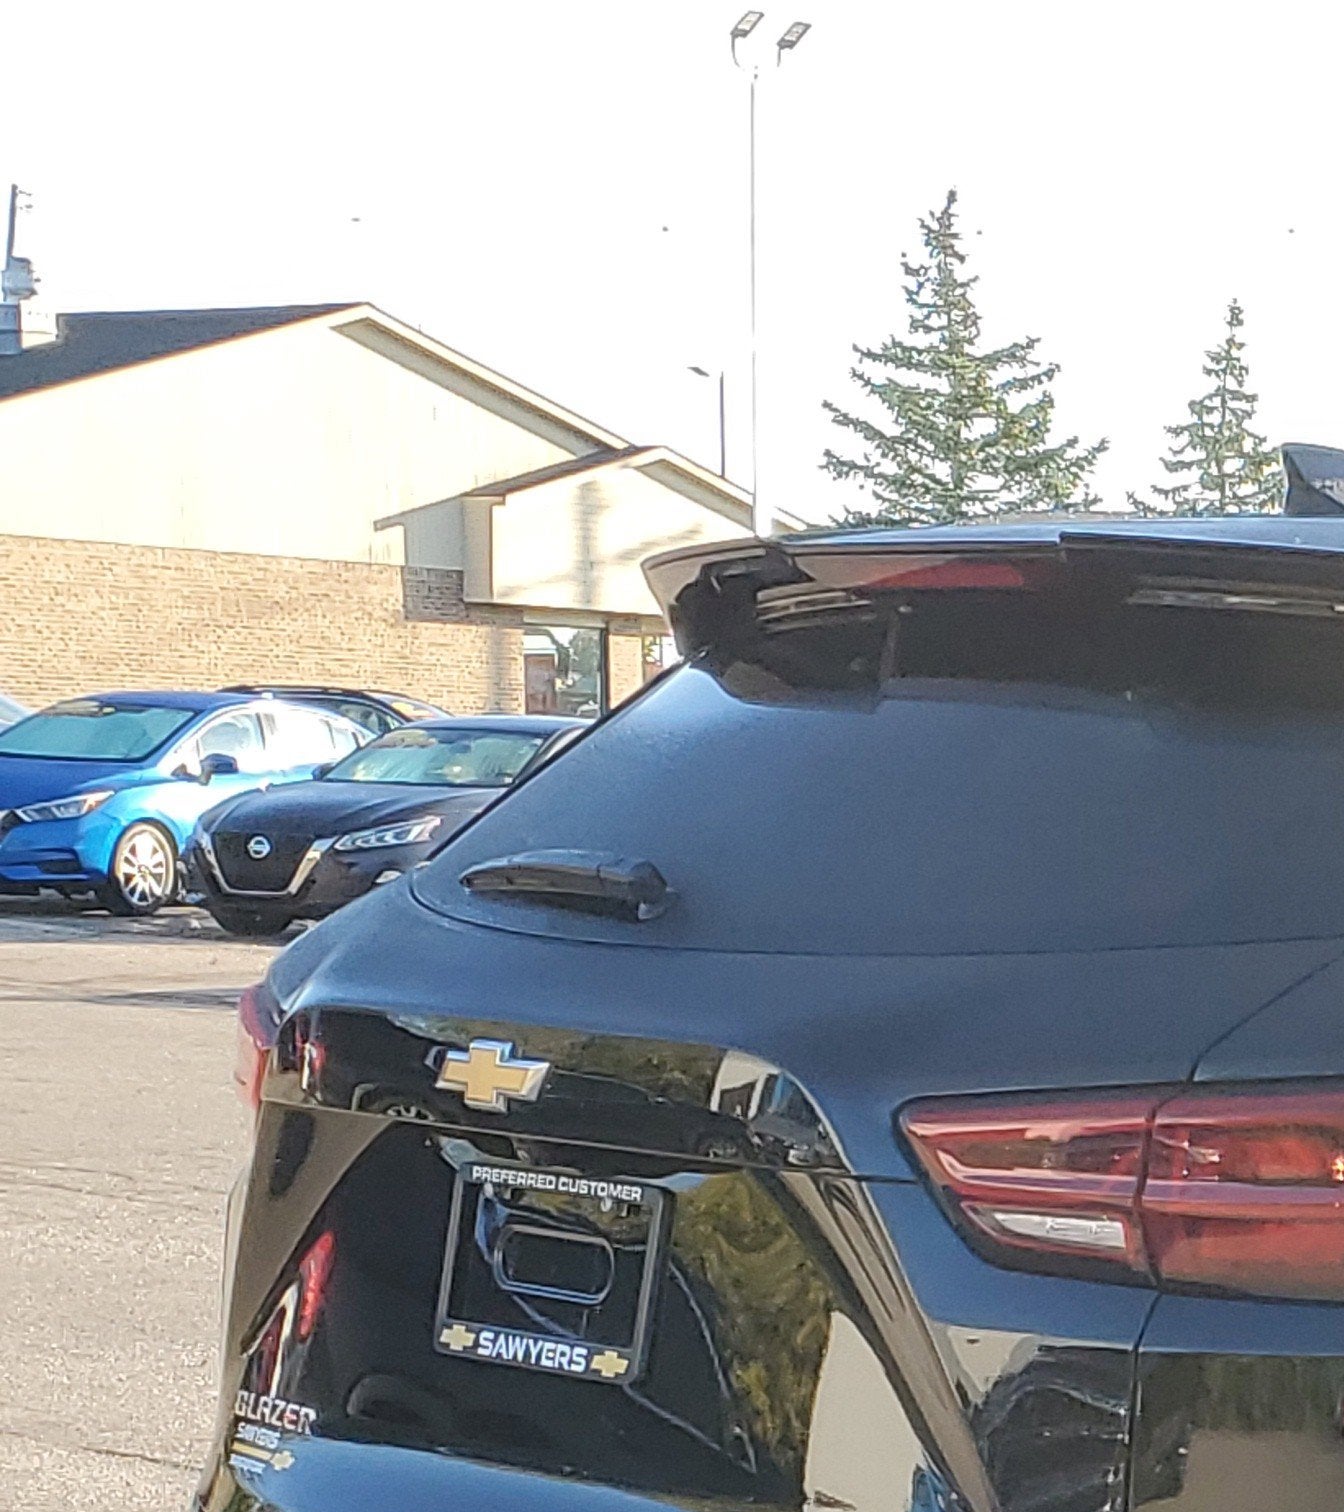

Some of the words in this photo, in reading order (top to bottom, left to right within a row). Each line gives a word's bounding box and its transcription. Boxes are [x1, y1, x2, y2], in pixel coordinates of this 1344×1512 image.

[472, 1165, 556, 1189] PREFERRED
[558, 1176, 642, 1201] CUSTOMER
[477, 1330, 589, 1373] SAWYERS
